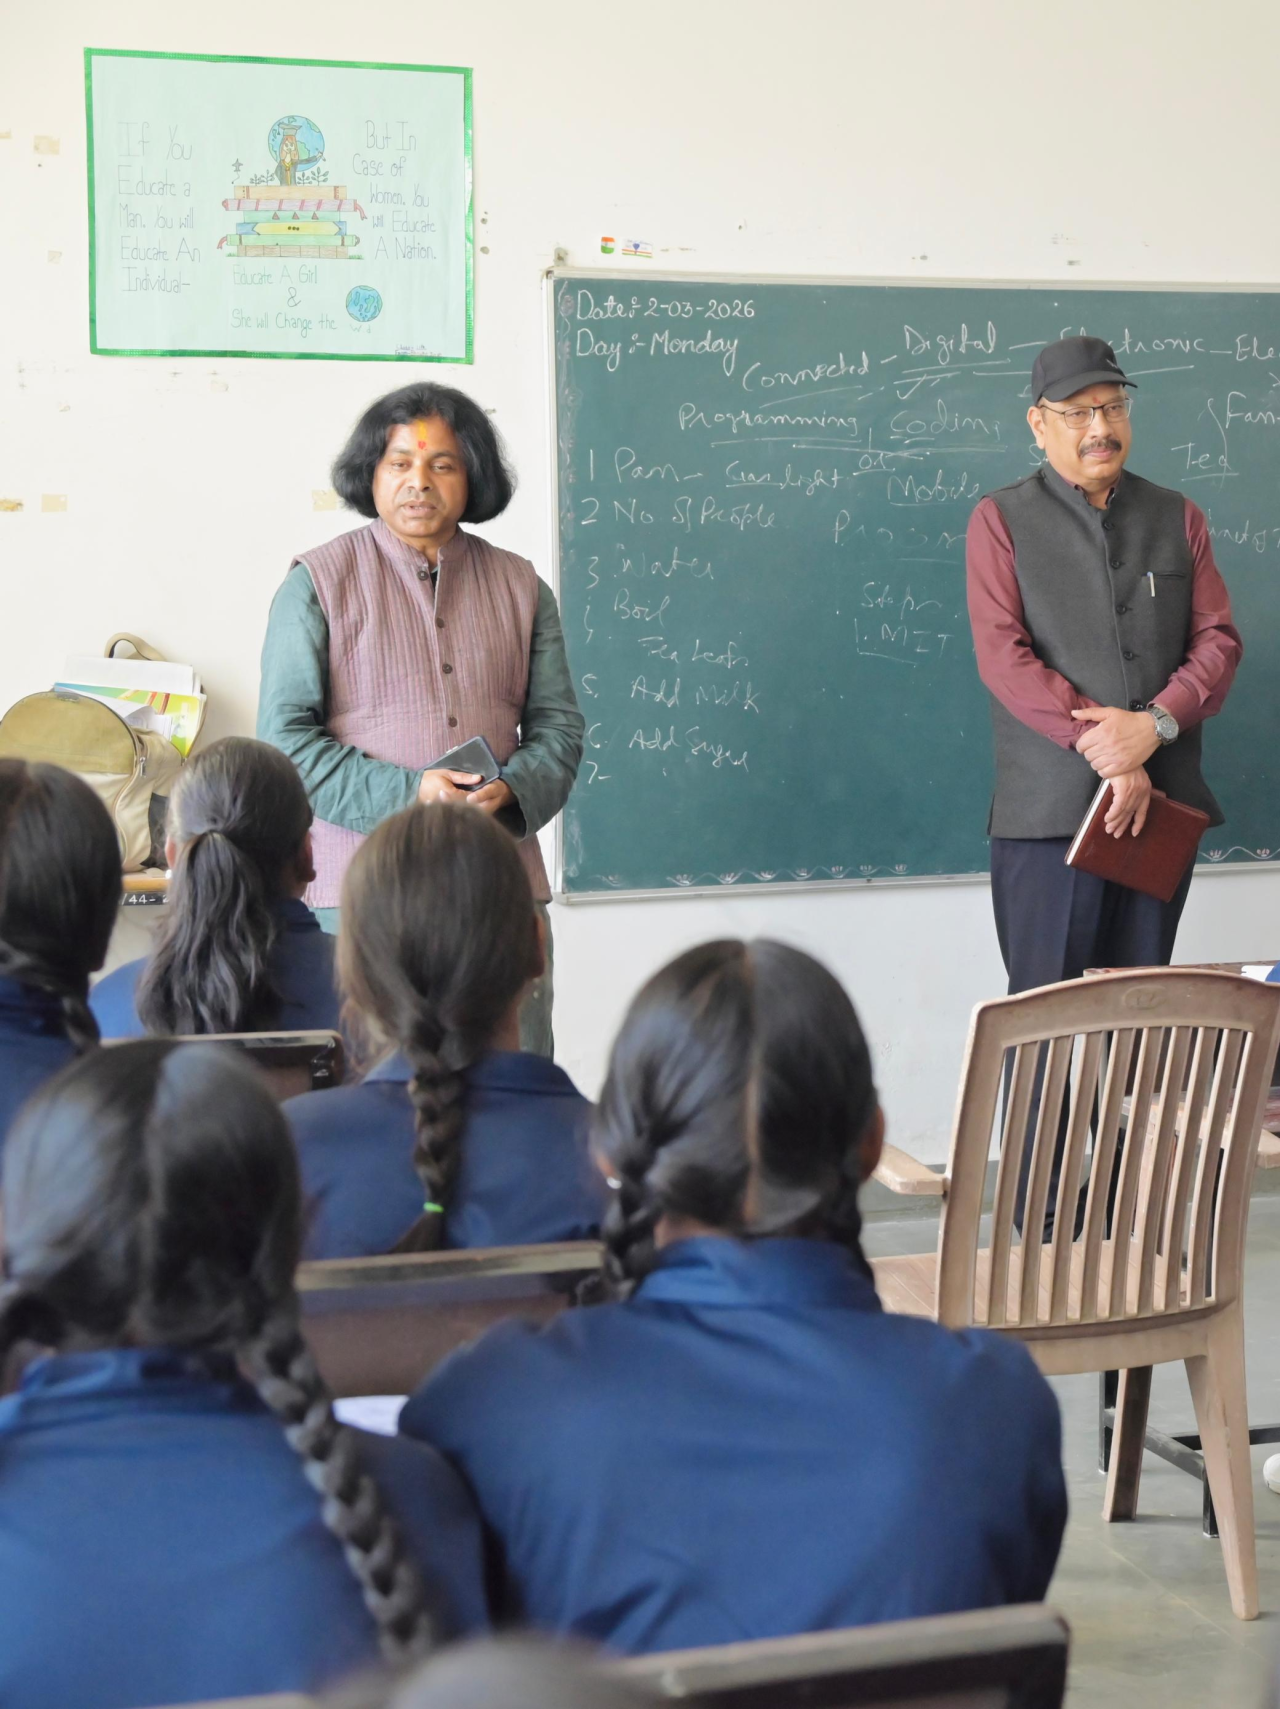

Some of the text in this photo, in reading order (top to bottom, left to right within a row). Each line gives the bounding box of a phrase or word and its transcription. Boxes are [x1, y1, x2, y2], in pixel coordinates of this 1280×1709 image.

[118, 121, 193, 160] If You
[365, 120, 417, 152] But In
[352, 154, 407, 177] Case of
[118, 164, 191, 197] Educate a
[411, 185, 430, 208] You
[119, 202, 194, 229] Man. You will
[391, 210, 436, 233] Educate
[120, 236, 201, 262] Educate An
[374, 236, 436, 260] A Nation.
[233, 264, 317, 286] Educate A Girl
[287, 286, 302, 307] &
[643, 297, 755, 319] 2-03-2026
[231, 308, 338, 338] She will Change the
[650, 328, 739, 377] Monday
[905, 320, 996, 365] Digital
[678, 398, 1001, 443] Programming Coding
[1171, 442, 1232, 470] Tea
[887, 469, 980, 502] Mobile
